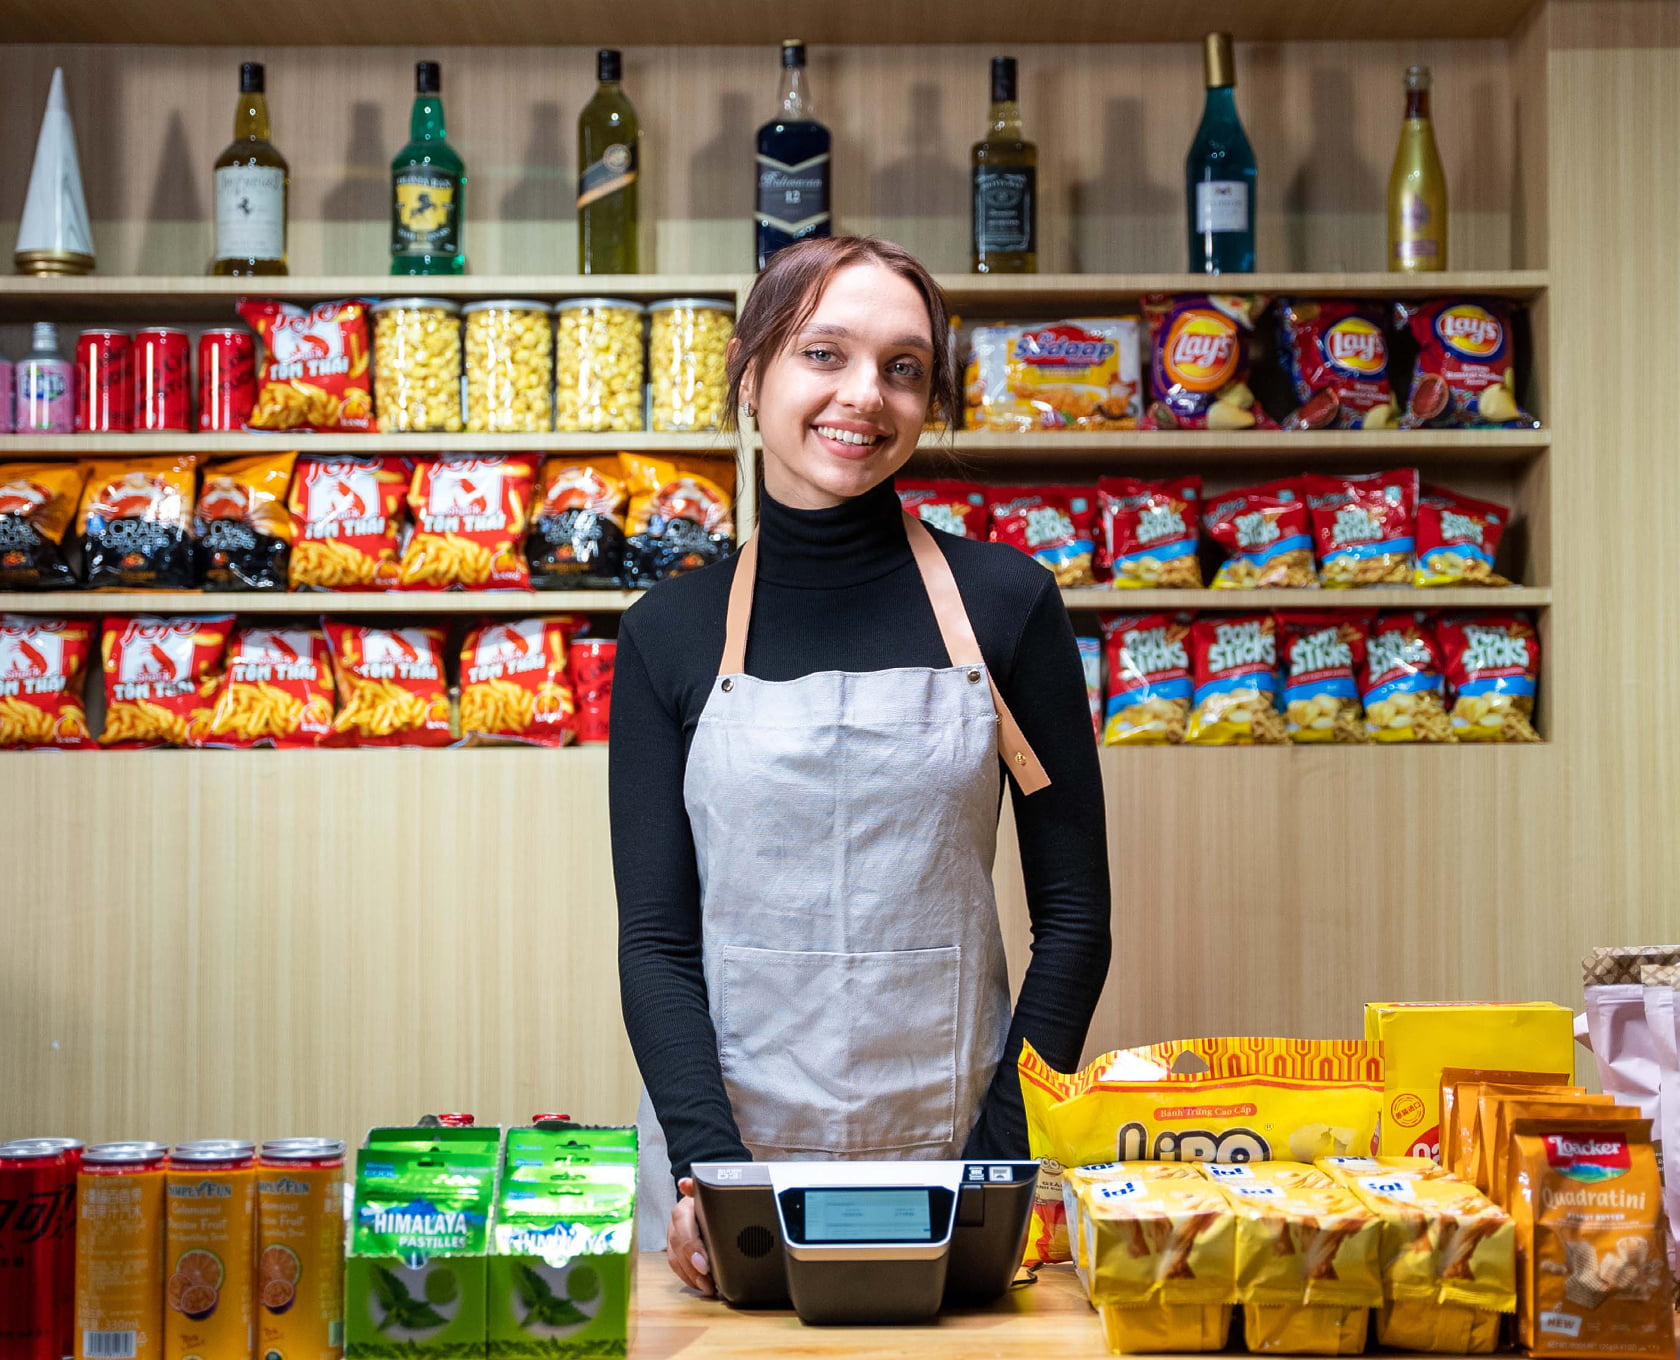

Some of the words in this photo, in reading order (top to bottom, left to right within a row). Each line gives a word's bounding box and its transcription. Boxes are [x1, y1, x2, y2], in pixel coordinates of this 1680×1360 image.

[109, 520, 164, 537] CRAB
[1215, 621, 1260, 647] POM
[1119, 641, 1189, 678] STICKS
[1208, 636, 1277, 673] STICKS
[1290, 643, 1352, 677] STICKS
[1462, 638, 1530, 673] STICKS
[1215, 1107, 1232, 1116] Cao
[1548, 1135, 1621, 1157] Loacker
[1542, 1187, 1648, 1211] Quadratini
[374, 1212, 467, 1235] HIMALAYA
[398, 1236, 467, 1249] PASTILLES
[1547, 1317, 1575, 1330] NEW
